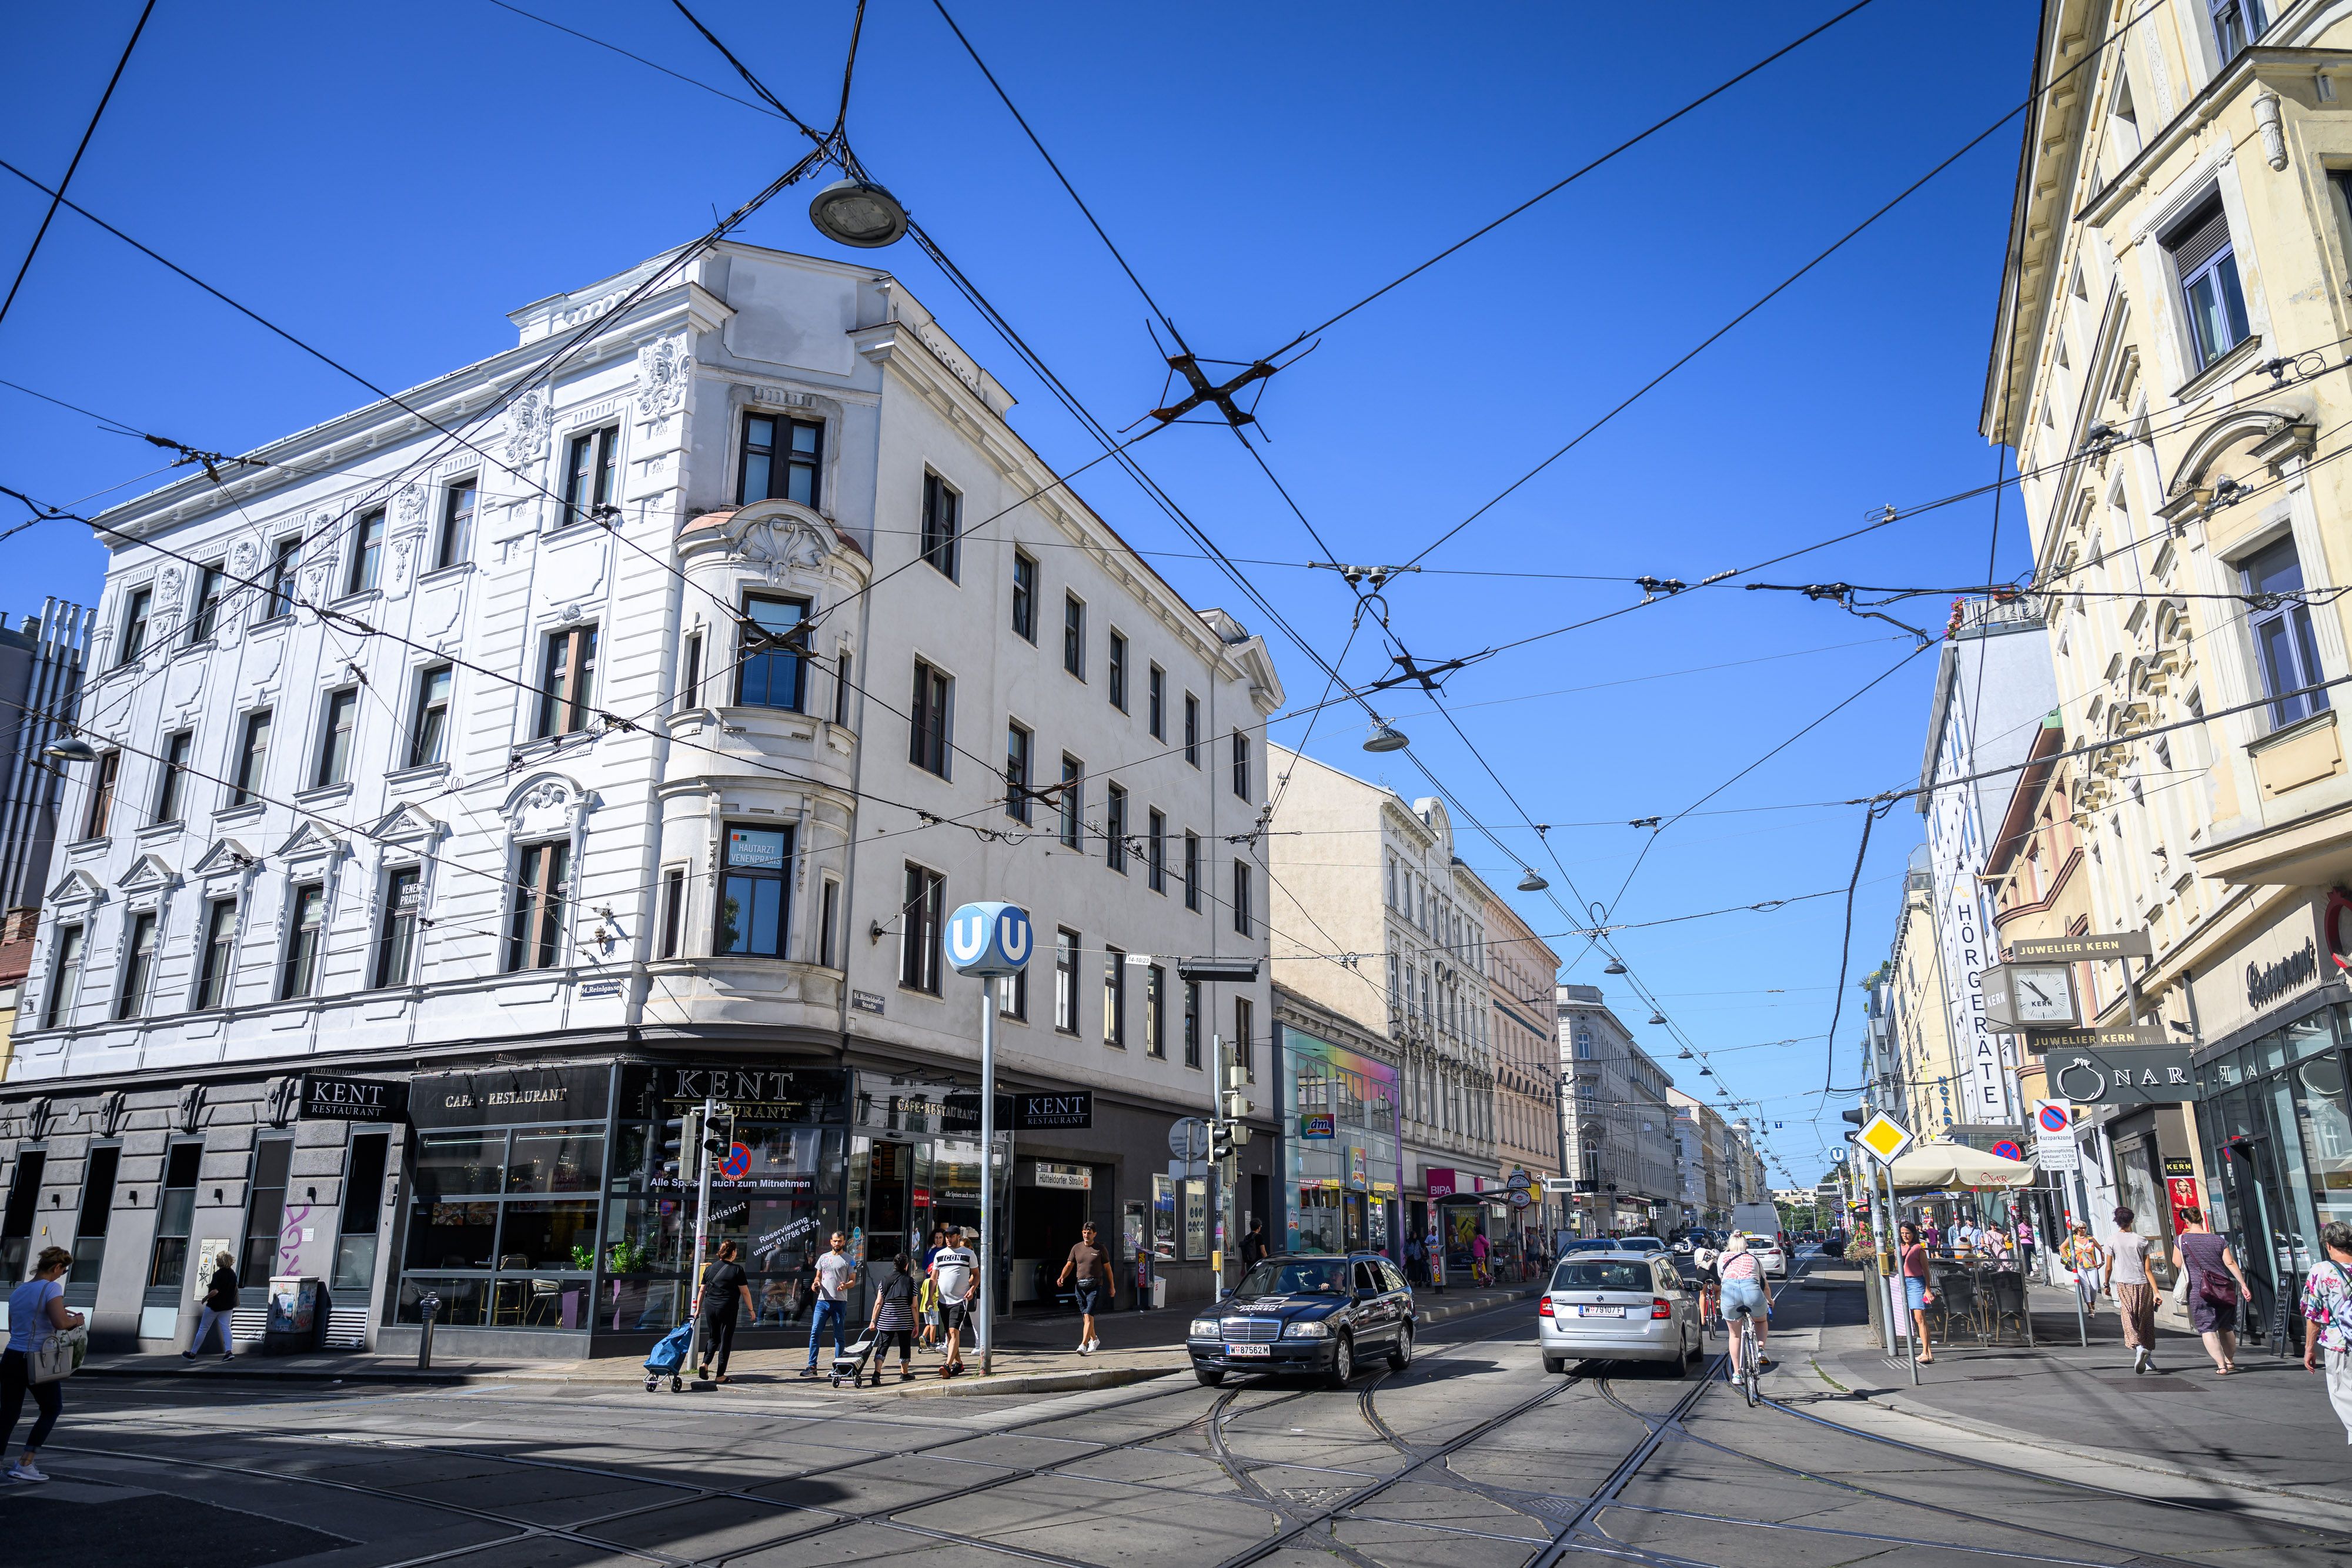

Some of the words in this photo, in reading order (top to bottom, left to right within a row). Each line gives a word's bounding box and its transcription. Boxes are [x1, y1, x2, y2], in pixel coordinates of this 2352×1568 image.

[739, 844, 776, 854] HAUTARZT
[731, 853, 781, 865] VENENPRAXIS
[953, 916, 982, 960] U
[1002, 916, 1026, 961] U
[2020, 943, 2082, 955] JUWELIER
[2087, 941, 2119, 950] KERN
[2247, 936, 2317, 1008] Restaurant
[862, 1001, 876, 1010] Straße
[1958, 904, 1998, 1104] HÖRGERÄTE
[1987, 991, 2005, 1007] KERN
[2034, 1035, 2096, 1046] JUWELIER
[2102, 1034, 2135, 1042] KERN
[674, 1069, 793, 1100] KENT
[313, 1081, 383, 1105] KENT
[488, 1088, 567, 1106] RESTAURANT
[1938, 1076, 1953, 1126] NOTAR
[312, 1104, 382, 1117] RESTAURANT
[1029, 1096, 1084, 1115] KENT
[1028, 1116, 1084, 1125] RESTAURANT
[1311, 1118, 1328, 1129] dm
[1355, 1153, 1363, 1172] dm
[1832, 1150, 1843, 1159] U
[650, 1178, 669, 1186] Alle
[712, 1179, 735, 1188] auch
[760, 1179, 810, 1188] Mitnehmen
[1039, 1174, 1067, 1185] Hütteldorfer
[1069, 1176, 1084, 1185] Straße
[1431, 1186, 1451, 1194] BIPA
[753, 1241, 776, 1256] unter:
[776, 1229, 800, 1245] 01/786
[800, 1223, 811, 1235] 62
[811, 1219, 821, 1231] 74
[759, 1216, 808, 1243] Reservierung
